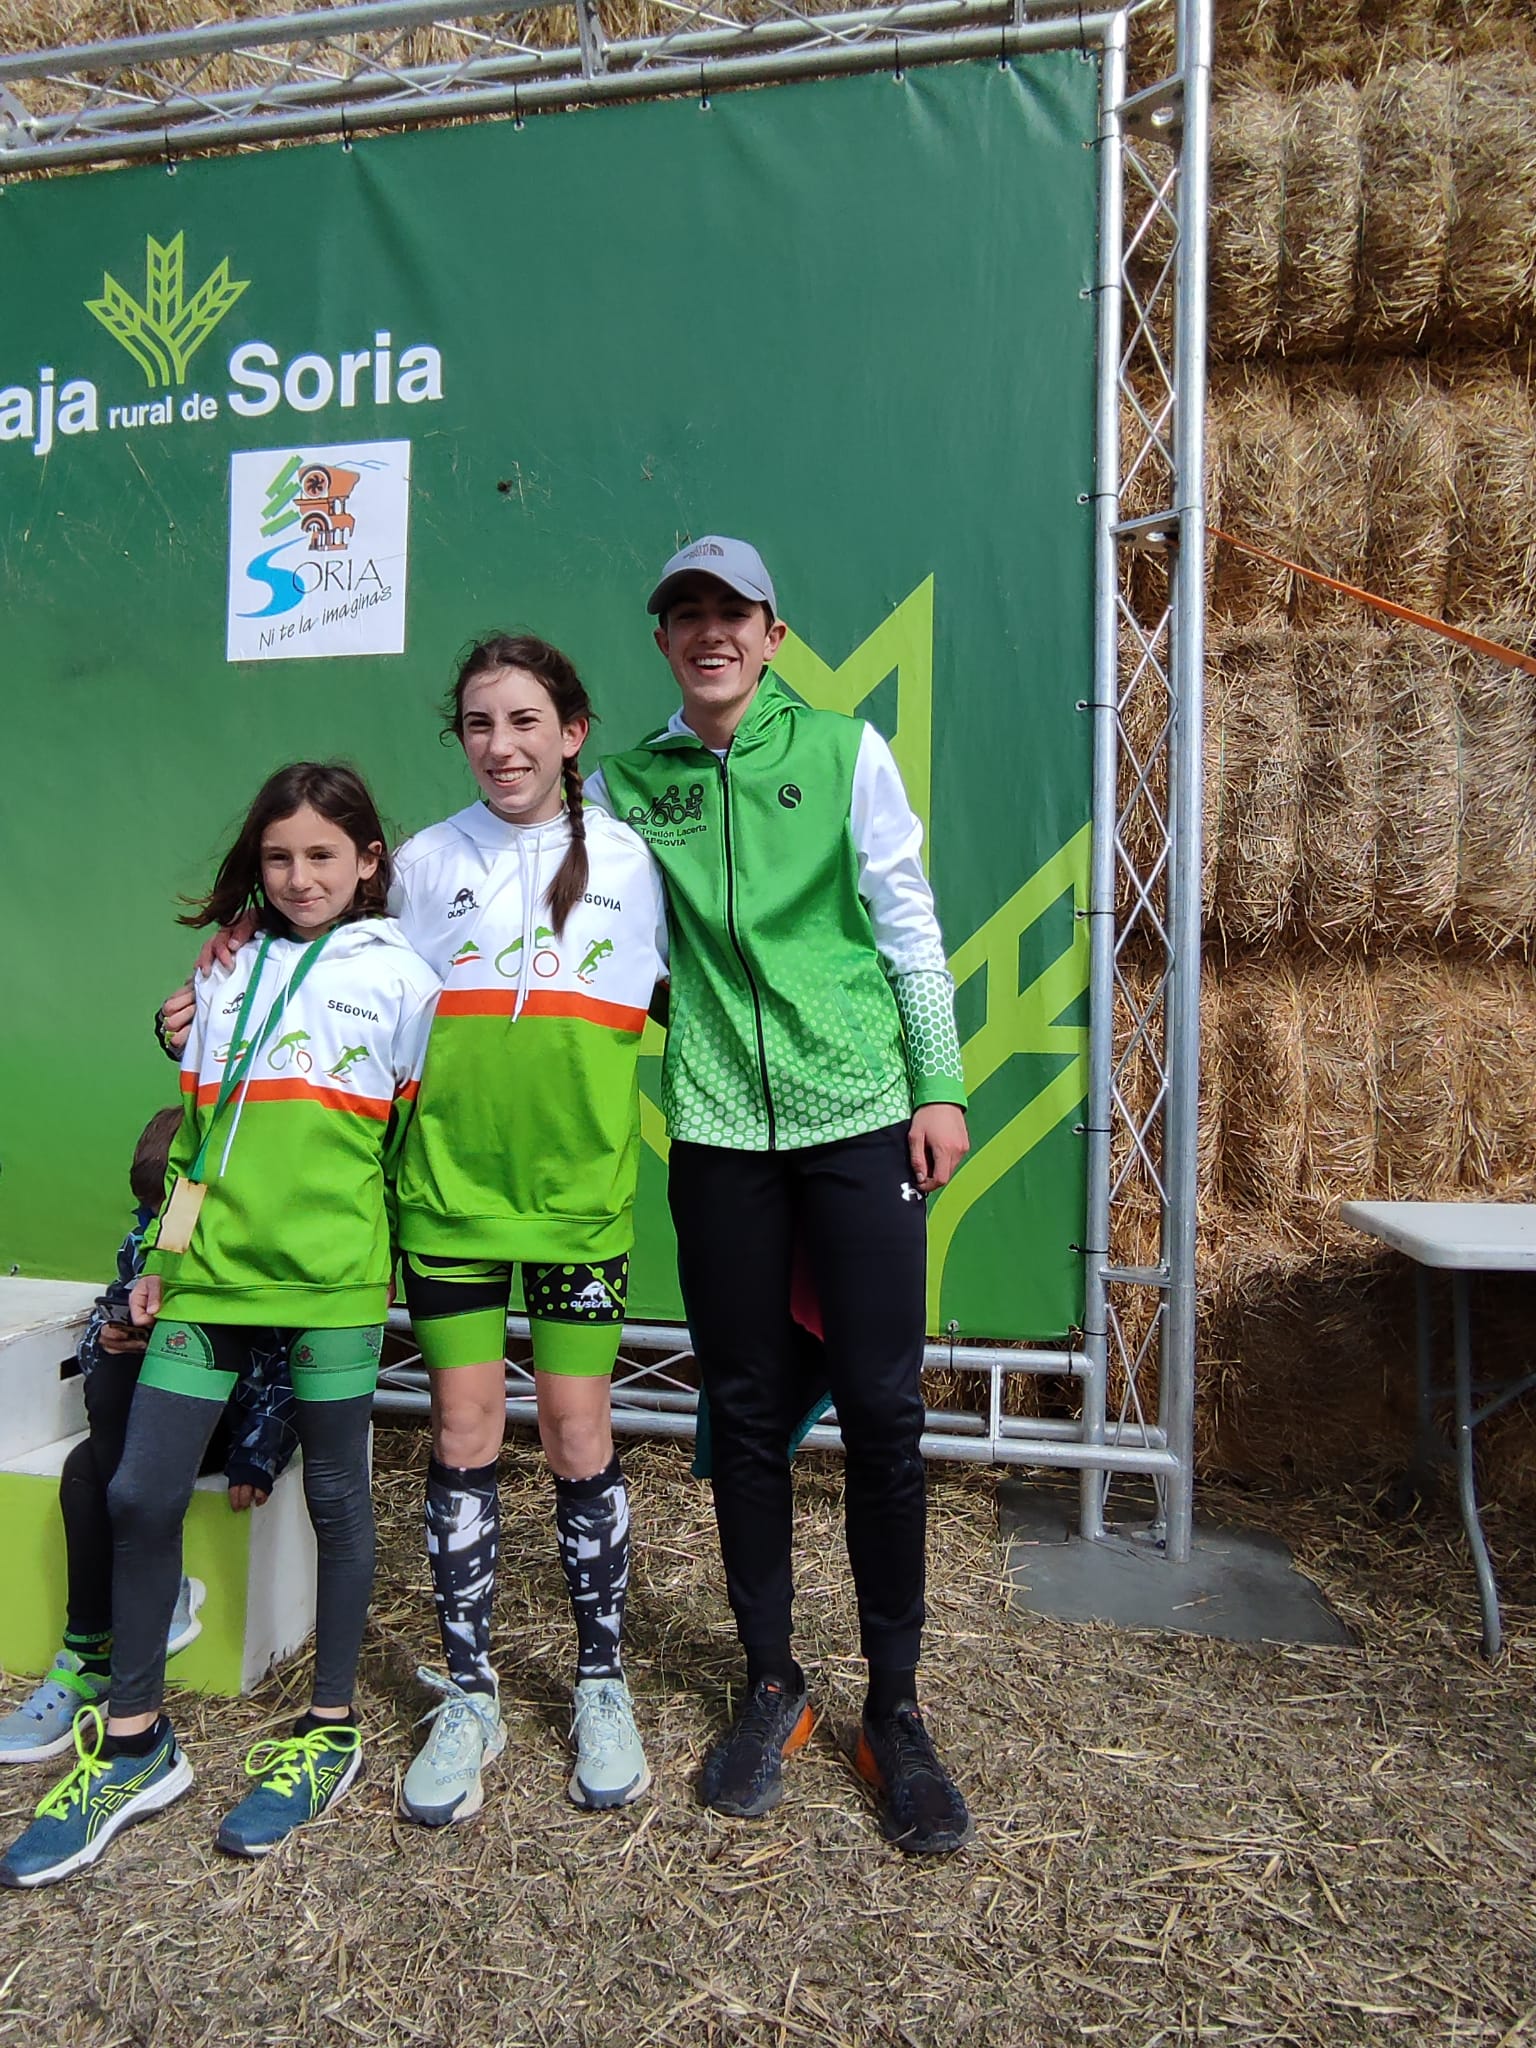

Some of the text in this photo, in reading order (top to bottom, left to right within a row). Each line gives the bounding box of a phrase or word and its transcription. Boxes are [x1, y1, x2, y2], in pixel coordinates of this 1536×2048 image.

[109, 396, 173, 429] rural
[181, 393, 218, 422] de
[228, 331, 444, 417] Soria
[235, 537, 384, 619] SORIA
[259, 585, 392, 652] Ni te la imaginas
[641, 827, 675, 838] Triatlón
[644, 837, 687, 847] SEGOVIA
[327, 999, 379, 1024] SEGOVIA
[570, 1299, 613, 1309] austral
